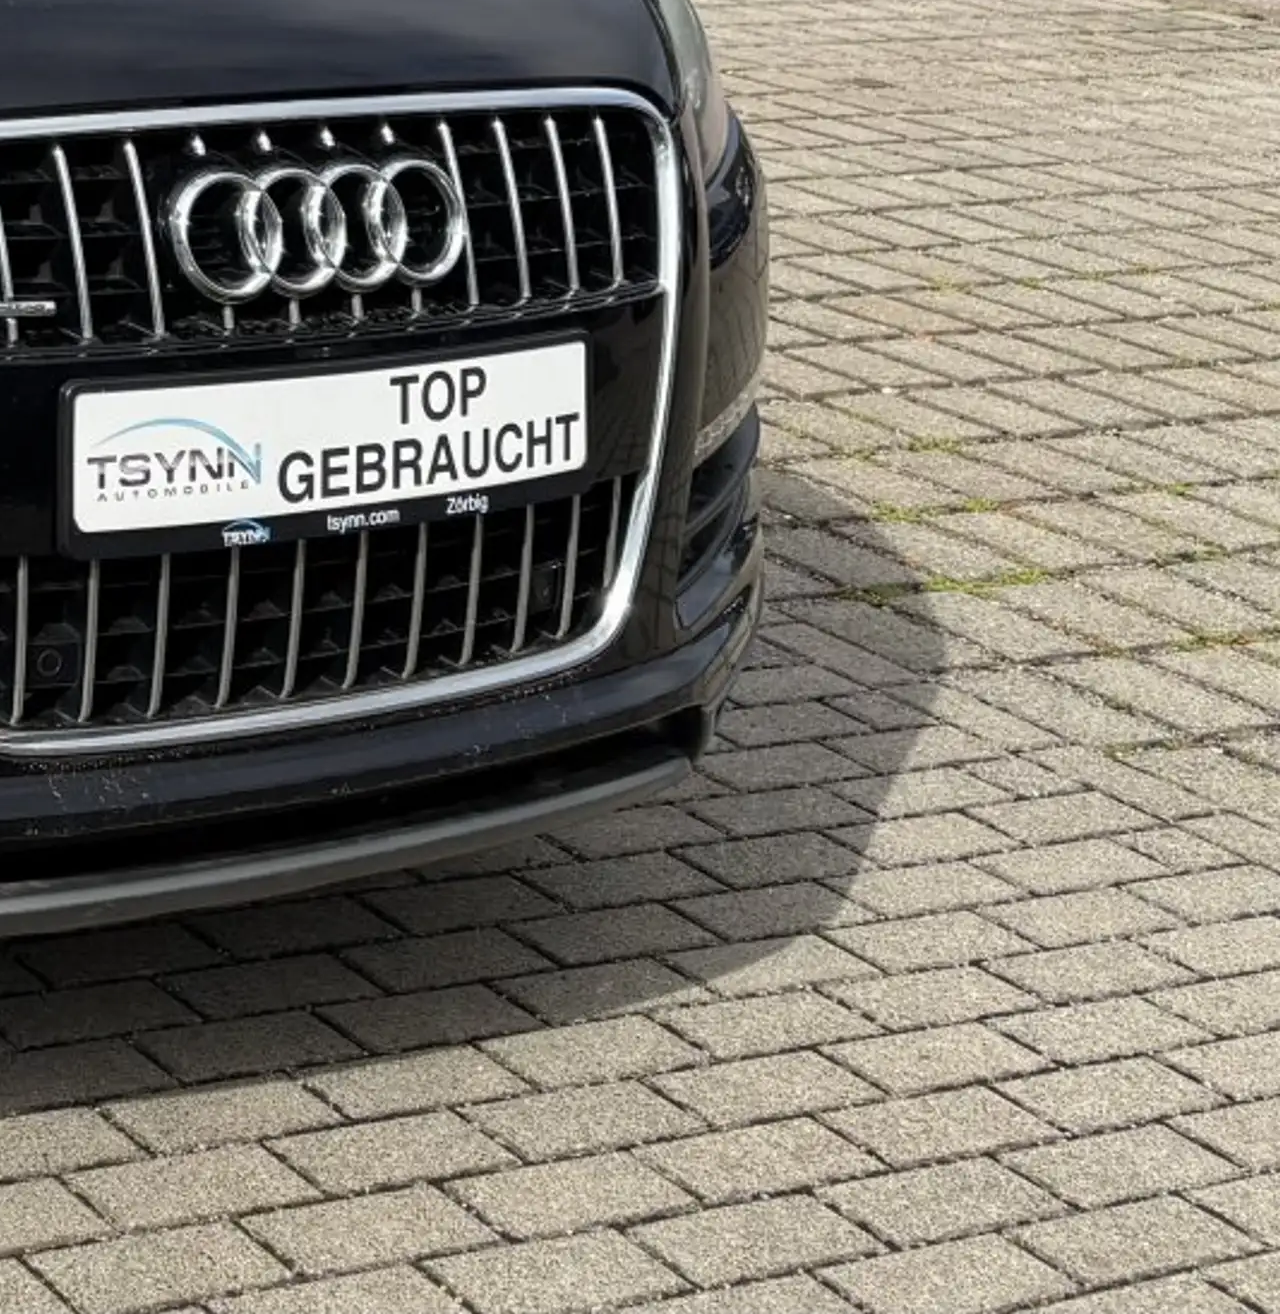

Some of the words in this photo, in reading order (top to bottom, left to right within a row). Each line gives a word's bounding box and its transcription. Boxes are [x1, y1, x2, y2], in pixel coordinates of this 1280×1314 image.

[389, 366, 487, 424] TOP
[87, 443, 262, 490] TSYNN
[278, 412, 580, 503] GEBRAUCHT
[97, 481, 249, 502] AUTOMOBILE
[327, 509, 400, 534] tsynn.com
[445, 492, 489, 515] Zörbig
